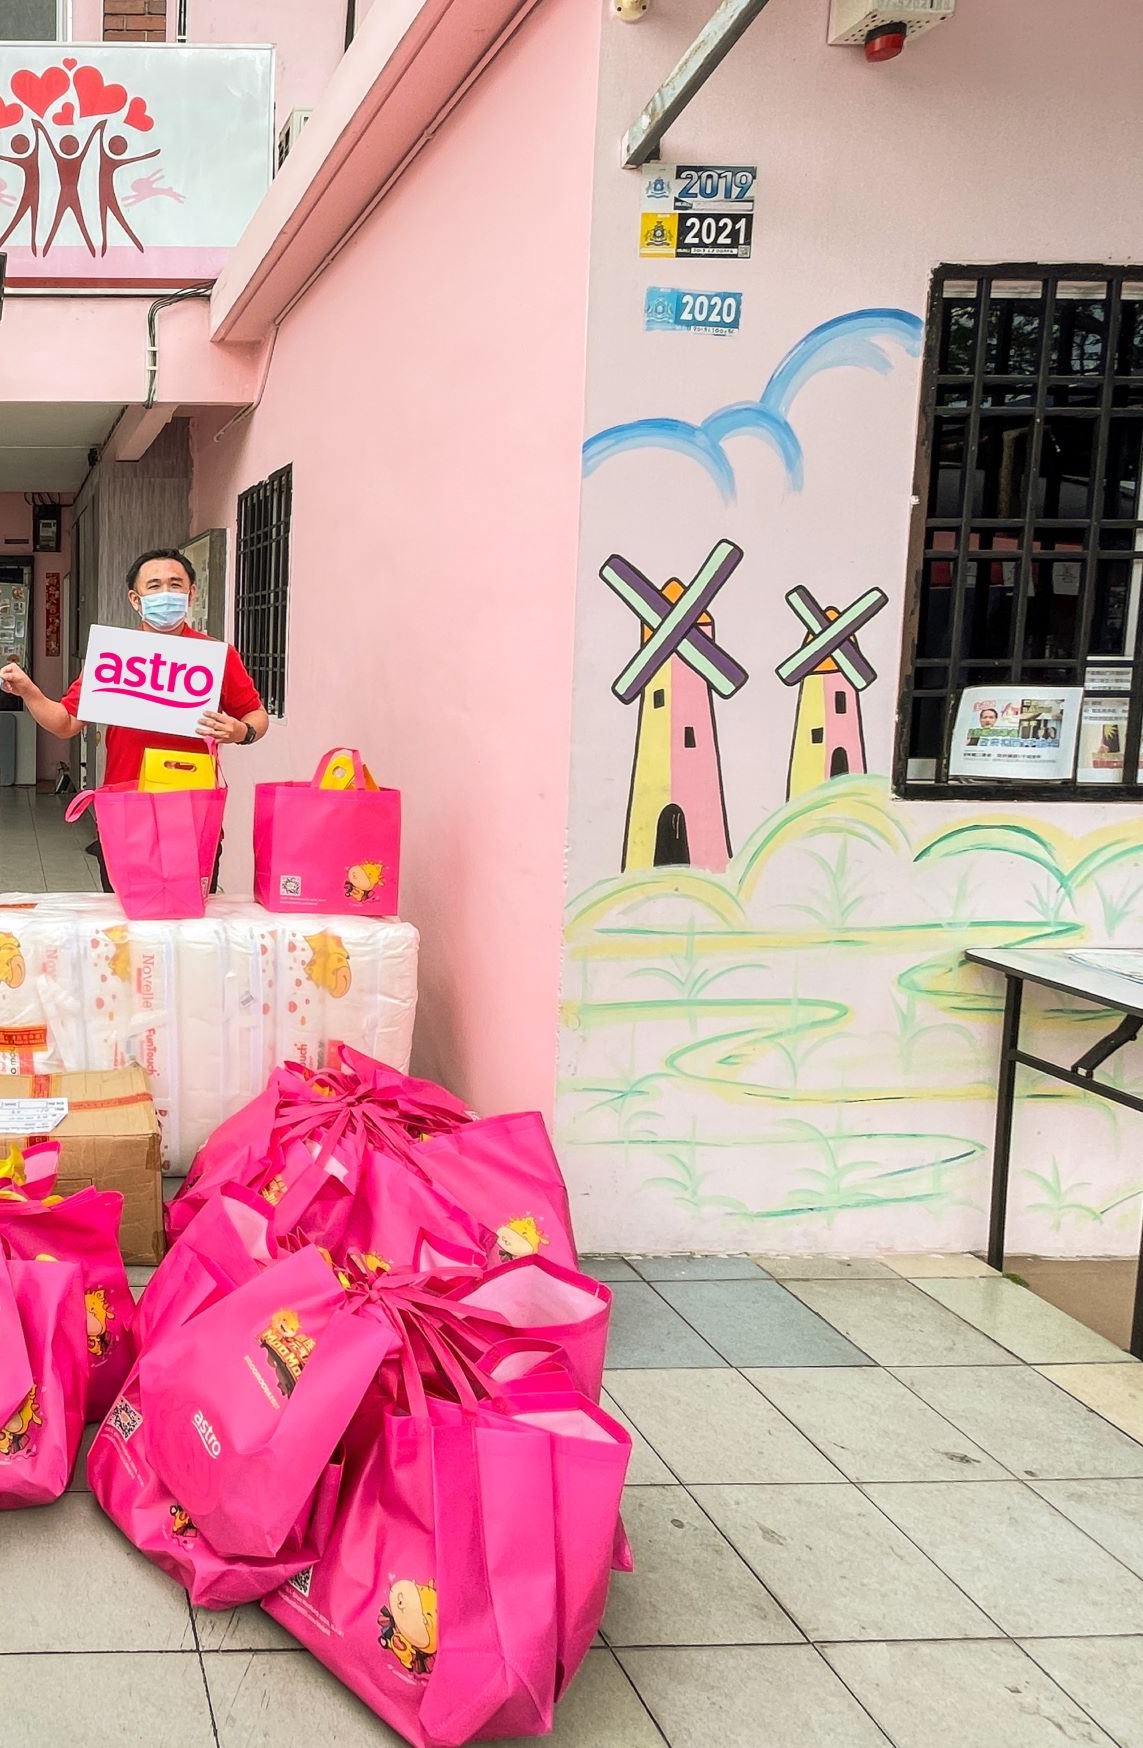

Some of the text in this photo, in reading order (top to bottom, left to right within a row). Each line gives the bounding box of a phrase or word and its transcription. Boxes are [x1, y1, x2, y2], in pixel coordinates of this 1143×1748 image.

[679, 170, 754, 200] 2019
[684, 217, 747, 244] 2021
[680, 294, 737, 324] 2020
[94, 651, 214, 698] astro
[142, 954, 155, 1009] Novelle
[145, 1028, 157, 1077] FunTouch
[192, 1410, 222, 1459] astro
